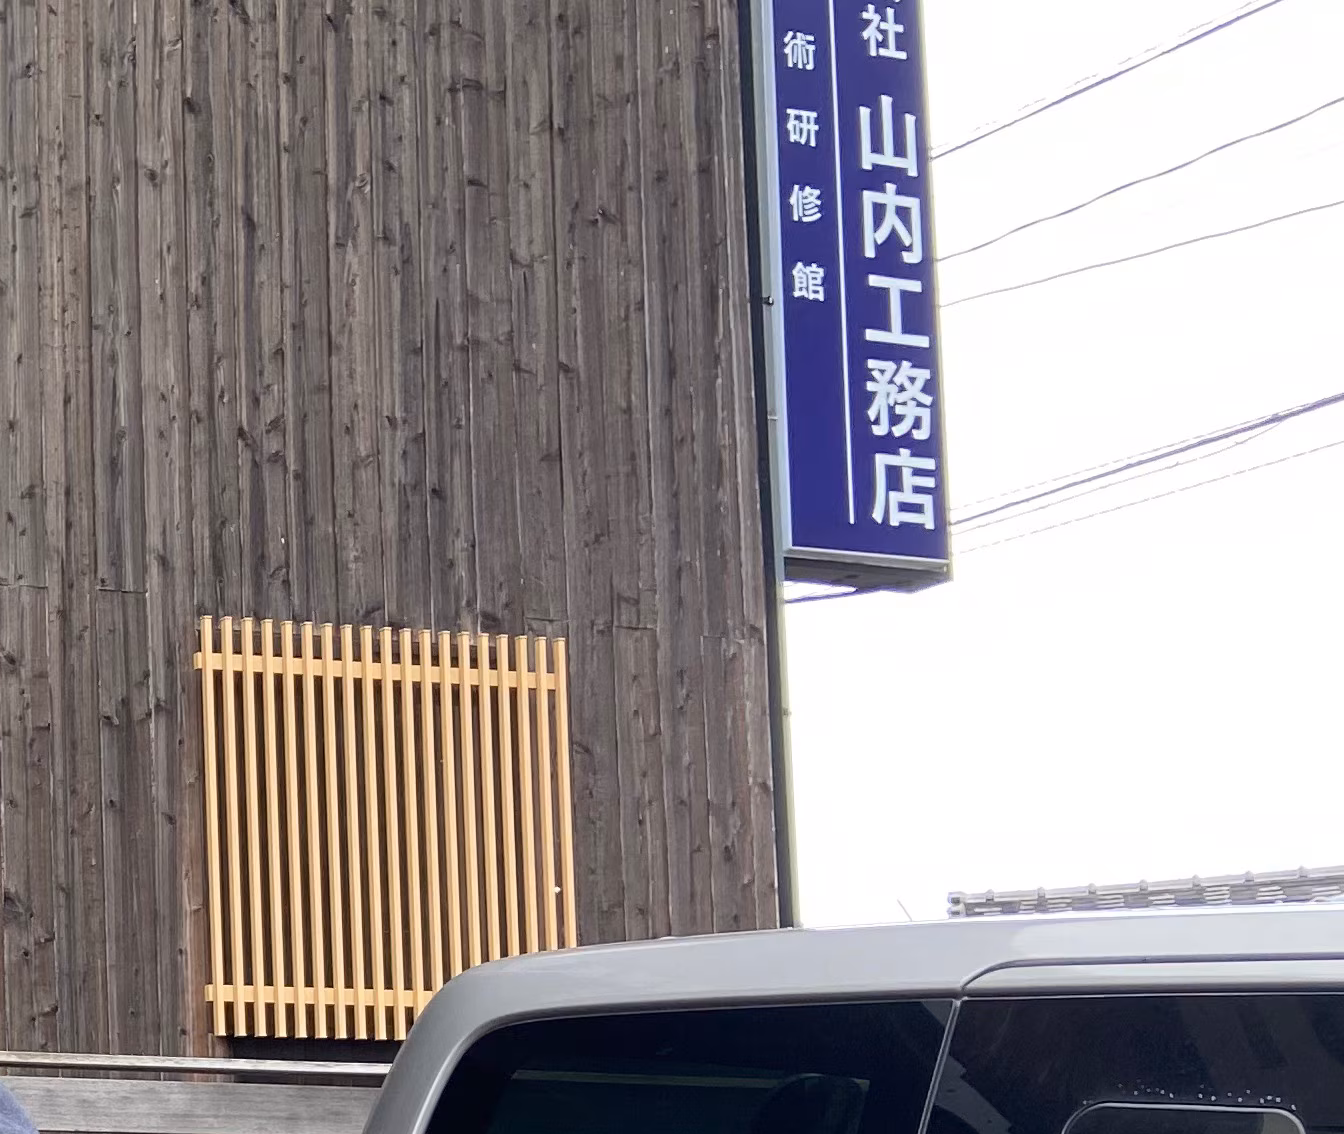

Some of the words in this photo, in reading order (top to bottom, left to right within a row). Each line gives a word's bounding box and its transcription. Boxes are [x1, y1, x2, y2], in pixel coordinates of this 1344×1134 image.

[783, 30, 825, 302] 術研修館
[861, 0, 908, 60] 社
[859, 94, 936, 531] 山内工務店
